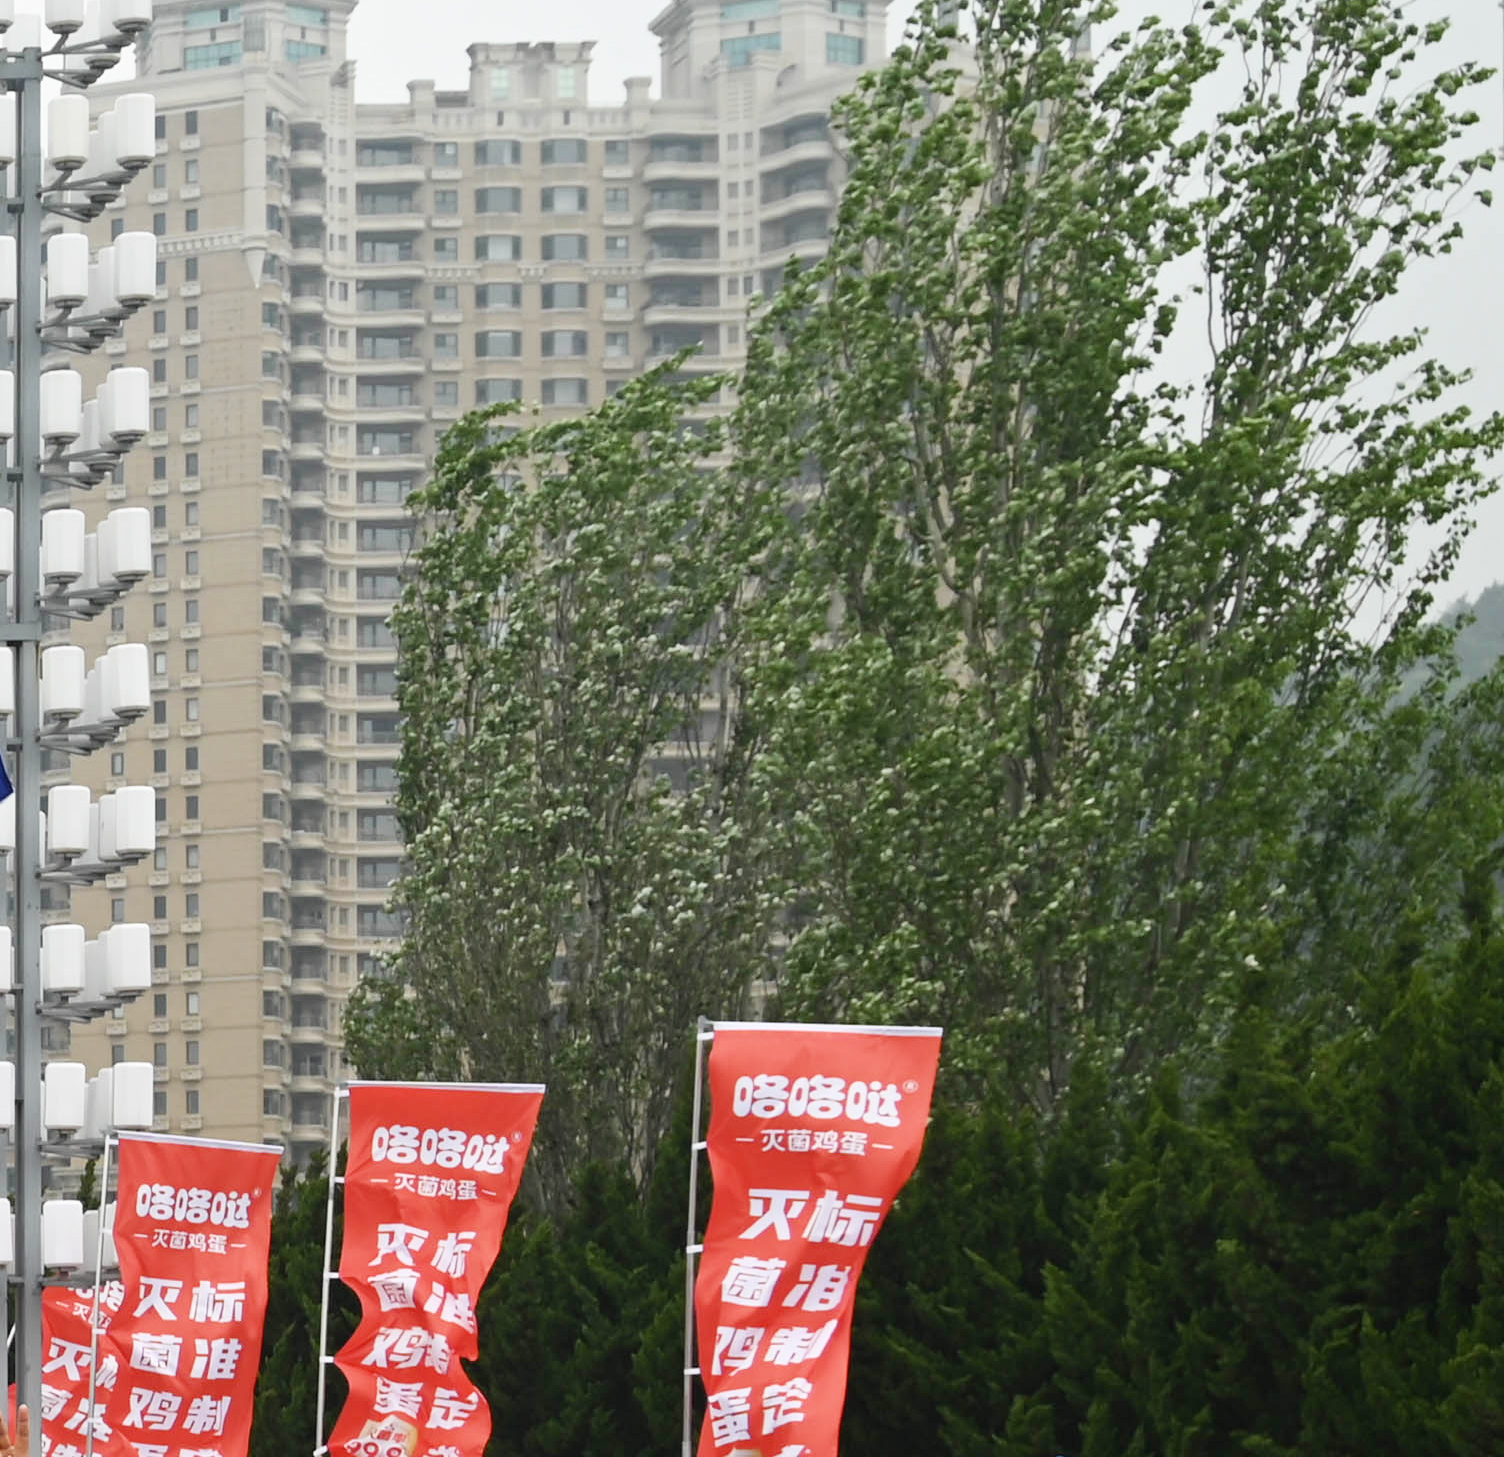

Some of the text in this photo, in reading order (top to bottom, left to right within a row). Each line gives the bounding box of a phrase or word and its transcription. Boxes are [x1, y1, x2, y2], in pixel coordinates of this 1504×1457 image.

[733, 1074, 902, 1127] 咯咯哒
[371, 1124, 510, 1175] 咯咯哒
[761, 1130, 866, 1156] 灭菌鸡蛋
[135, 1183, 252, 1229] 咯咯哒
[394, 1173, 477, 1200] 灭菌鸡蛋
[152, 1230, 226, 1254] 灭菌鸡蛋
[362, 1223, 429, 1418] 灭菌鸡蛋
[707, 1188, 810, 1448] 灭菌鸡蛋
